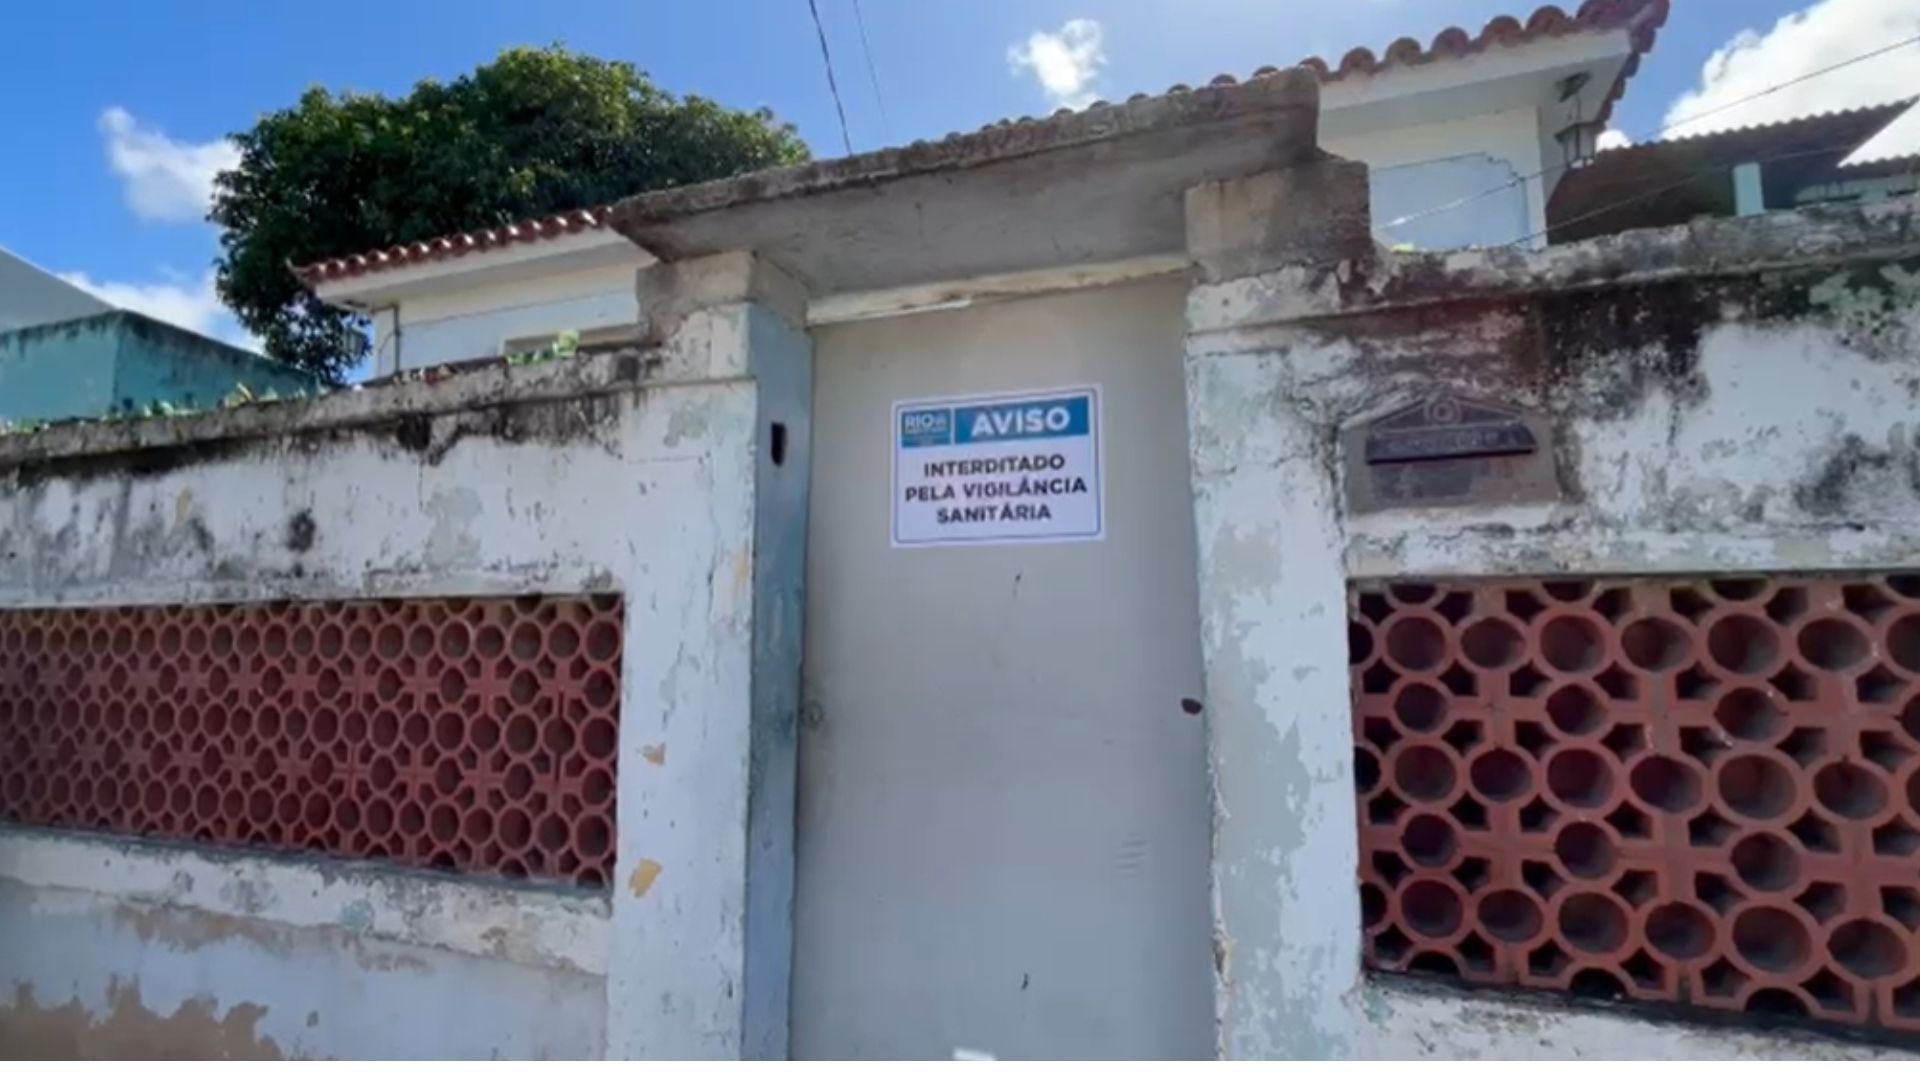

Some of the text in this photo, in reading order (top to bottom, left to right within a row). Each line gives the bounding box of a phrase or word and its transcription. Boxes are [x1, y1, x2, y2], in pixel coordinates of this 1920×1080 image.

[904, 413, 934, 430] RIO
[971, 406, 1071, 437] AVISO
[924, 454, 1065, 477] INTERDITADO
[906, 477, 1088, 502] PELA VIGILÂNCIA
[936, 504, 1052, 524] SANITÁRIA
